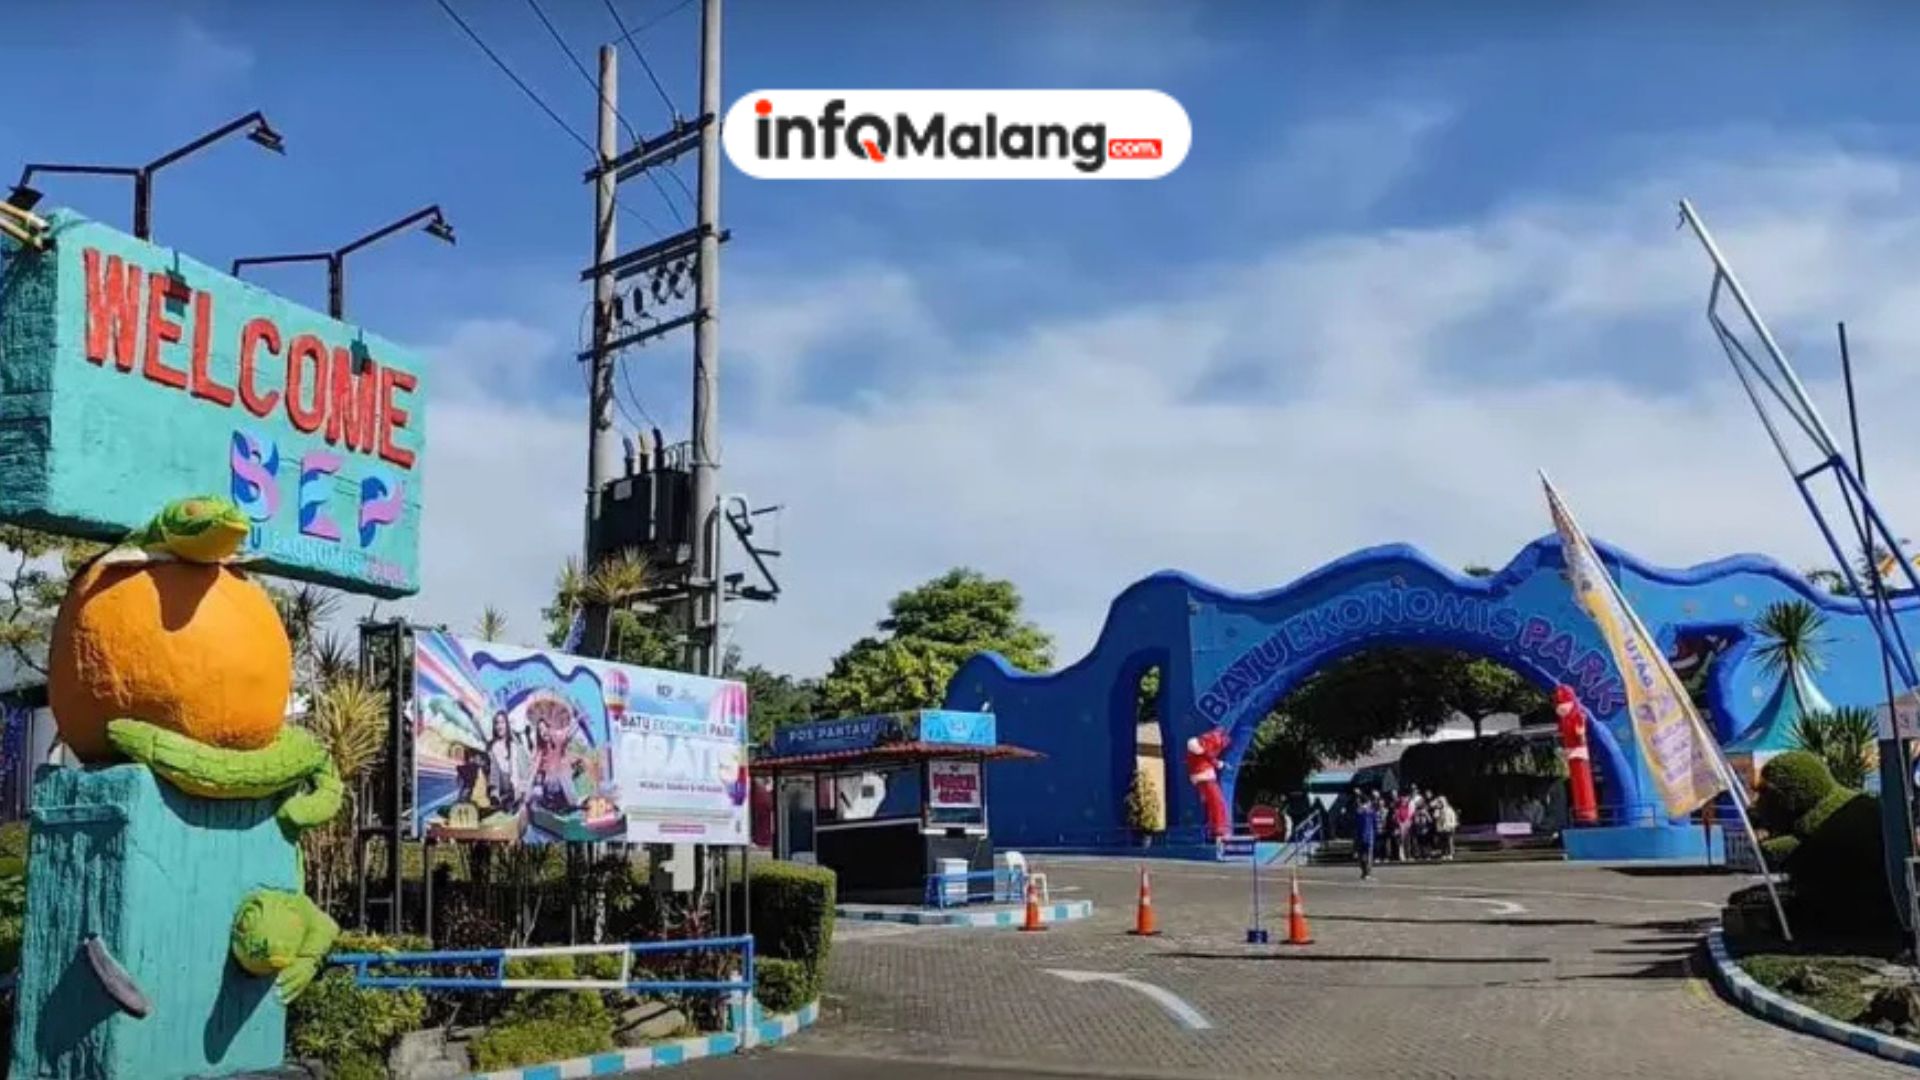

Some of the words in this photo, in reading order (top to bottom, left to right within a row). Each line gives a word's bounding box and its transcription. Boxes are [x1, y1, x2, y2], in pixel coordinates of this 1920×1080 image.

[83, 247, 419, 469] WELCOME
[1196, 623, 1288, 724] BATU
[1283, 586, 1522, 652] EKONOMIS
[1520, 615, 1628, 716] PARK
[620, 714, 650, 730] BATU
[789, 728, 814, 741] POS
